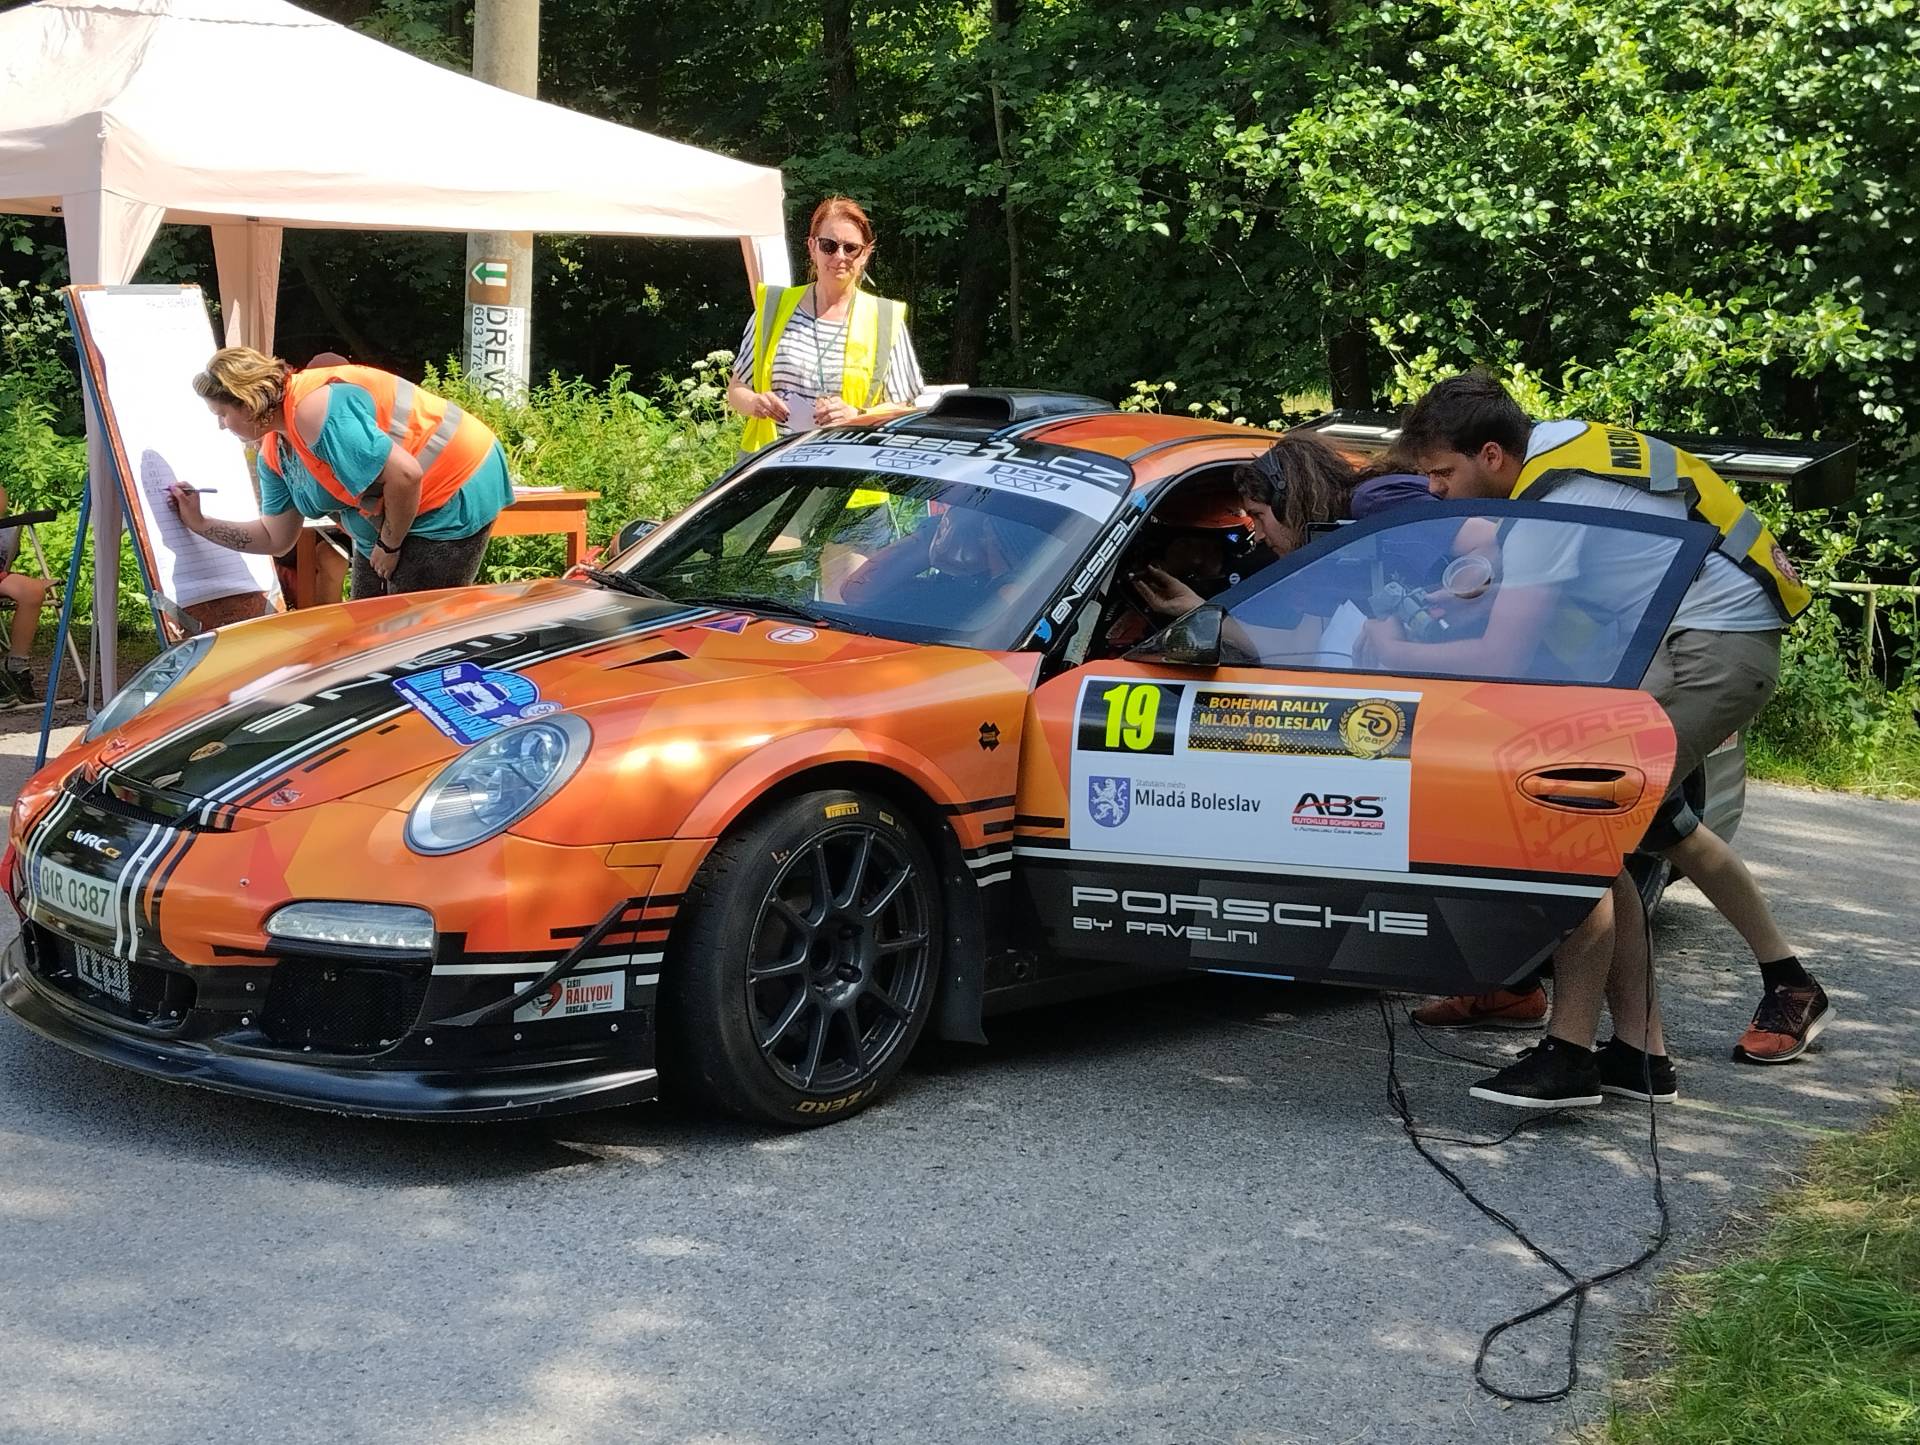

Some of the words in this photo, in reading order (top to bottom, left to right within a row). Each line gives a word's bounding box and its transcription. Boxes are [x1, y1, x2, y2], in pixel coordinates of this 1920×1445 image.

[473, 306, 485, 336] 603
[1209, 697, 1278, 711] BOHEMIA
[1281, 700, 1328, 713] RALLY
[1103, 684, 1161, 751] 19
[1200, 711, 1249, 728] MLADÁ
[1254, 716, 1332, 731] BOLESLAV
[1358, 708, 1392, 737] 50
[1245, 733, 1280, 746] 2023
[1356, 735, 1385, 746] year
[825, 802, 860, 819] PIRELLI
[1135, 788, 1186, 808] Mladá
[1191, 792, 1261, 812] Boleslav
[1293, 792, 1384, 818] ABS
[1293, 816, 1329, 826] AUTOKLUB
[1329, 818, 1360, 828] BOHEMIA
[1361, 820, 1384, 829] SPORT
[66, 829, 122, 859] eWRC.cz
[42, 866, 64, 903] 01R
[68, 878, 111, 918] 0387
[1072, 886, 1428, 936] PORSCHE
[1073, 916, 1113, 932] BY
[1126, 920, 1258, 945] PAVELINI
[566, 984, 613, 1005] RALLYOVÍ
[796, 1090, 863, 1113] ZERO
